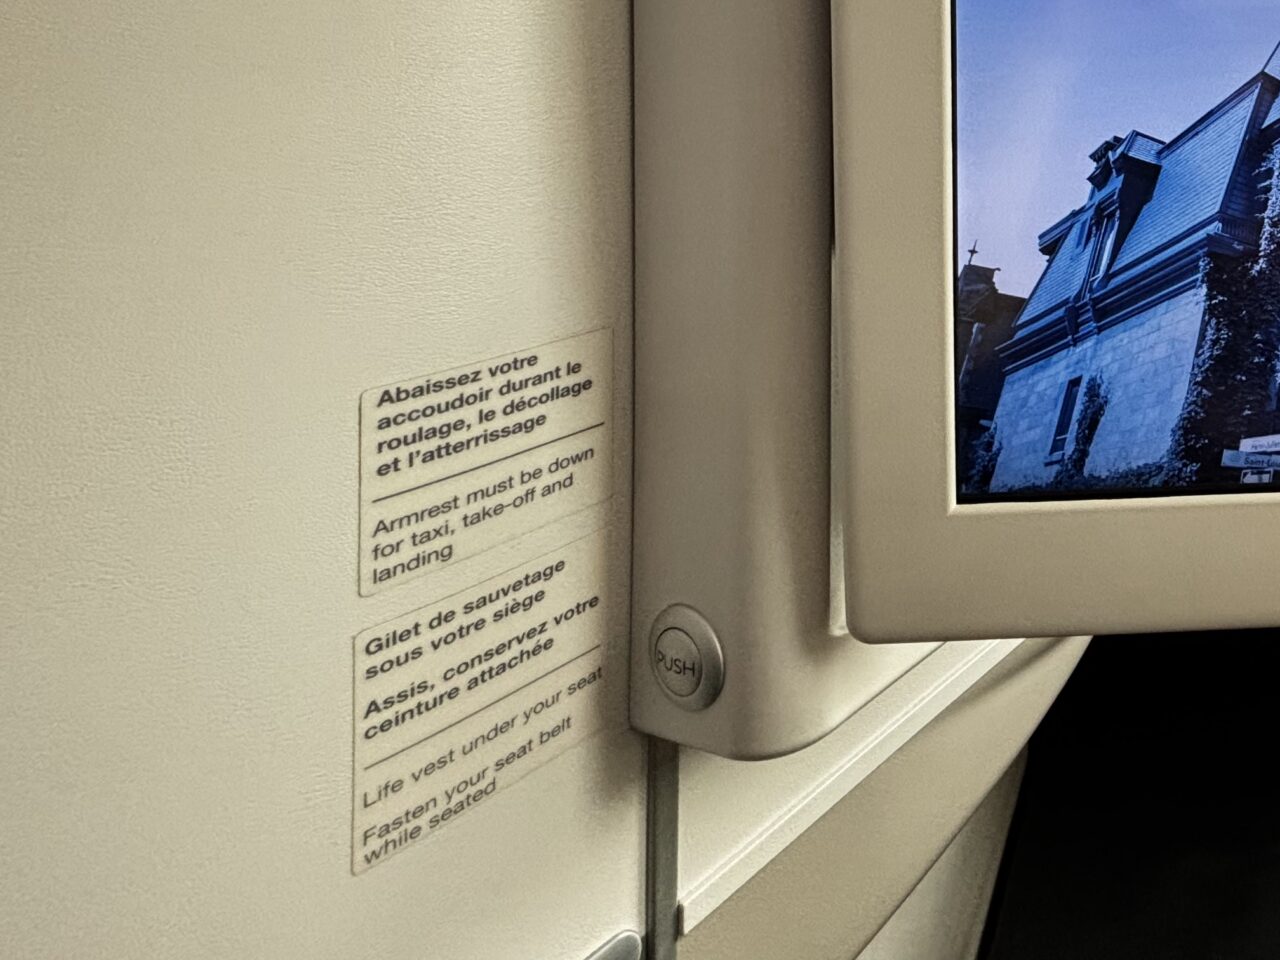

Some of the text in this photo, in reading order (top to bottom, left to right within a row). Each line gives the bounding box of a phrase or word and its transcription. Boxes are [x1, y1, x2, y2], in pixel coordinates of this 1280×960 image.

[376, 354, 539, 408] Abaissez votre
[376, 378, 593, 454] roulage, le décollage
[377, 361, 582, 431] accoudoir durant le
[371, 447, 595, 538] Armrest must be down
[376, 457, 401, 477] et
[372, 472, 575, 561] for taxi, take-off and
[365, 559, 566, 656] Gilet de sauvetage
[373, 543, 454, 584] landing
[362, 594, 600, 721] Assis, conservez votre
[365, 589, 546, 680] sous votre siège
[655, 649, 696, 678] PUSH
[363, 637, 555, 740] ceinture attachée
[362, 666, 604, 809] Life vest under your seat
[362, 715, 573, 847] Fasten your seat belt
[362, 777, 497, 866] while seated
